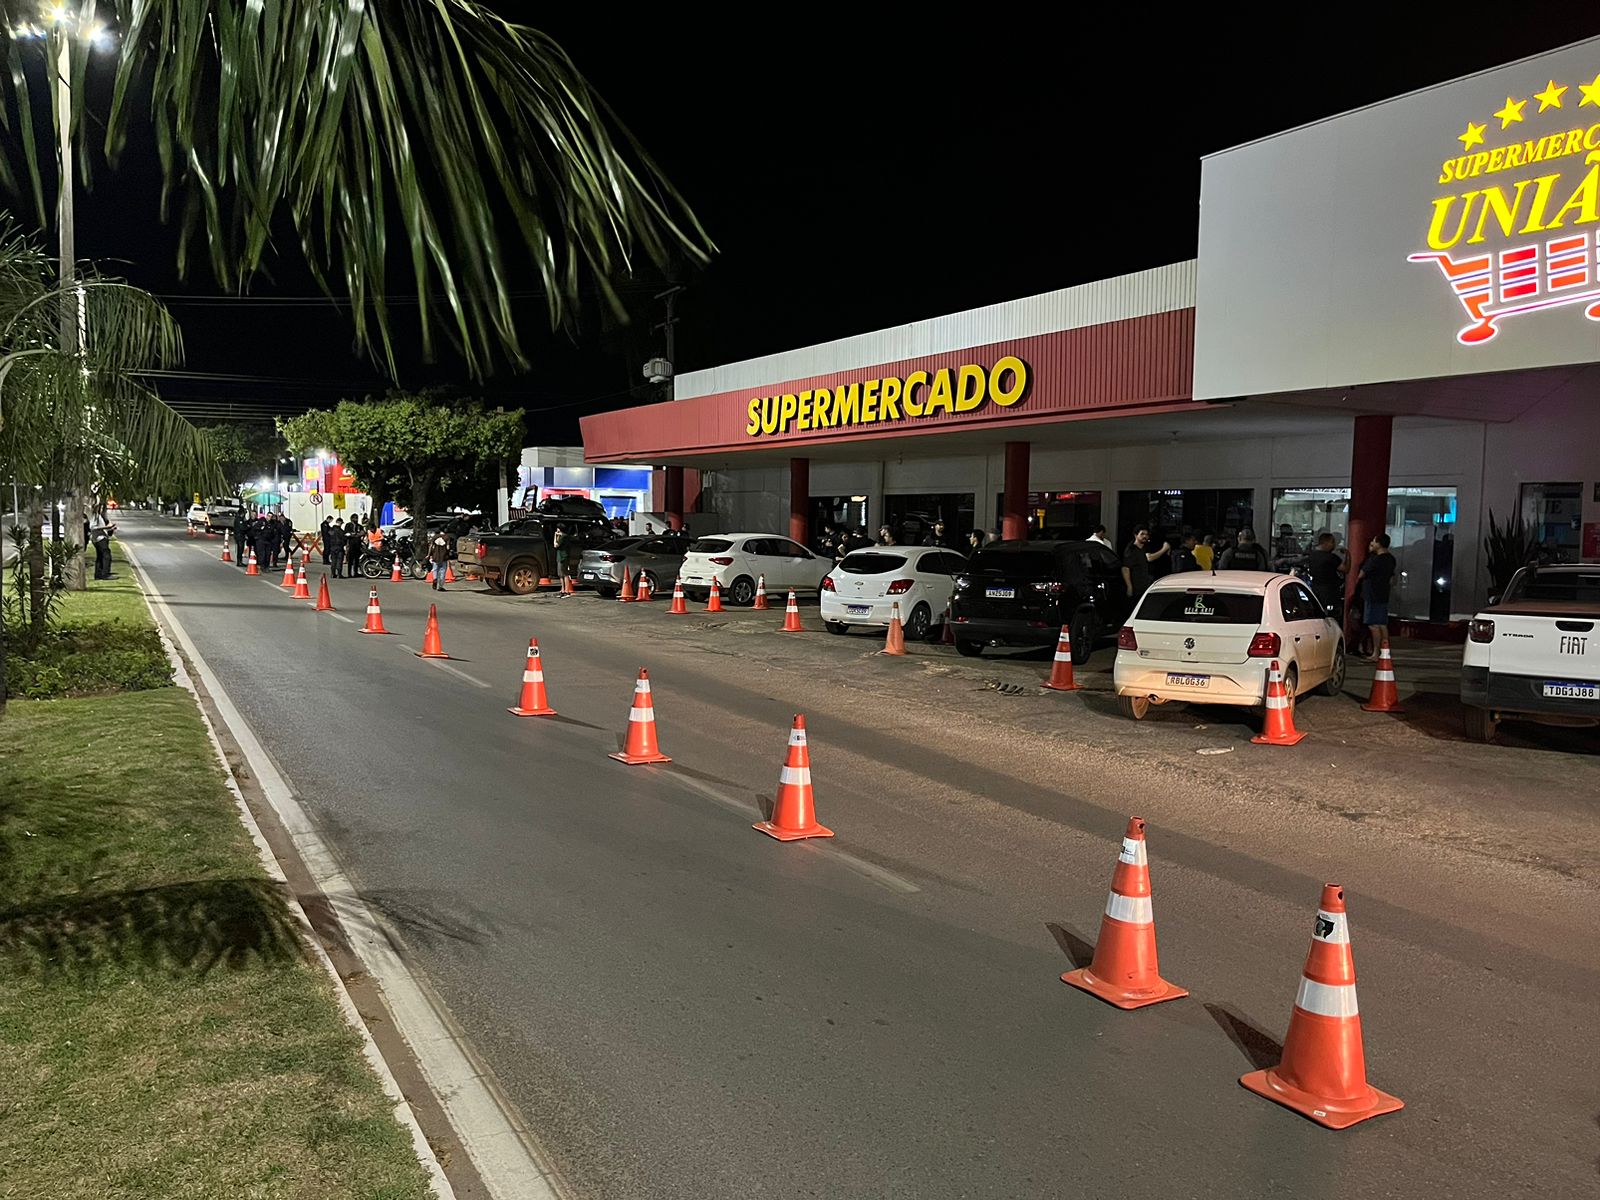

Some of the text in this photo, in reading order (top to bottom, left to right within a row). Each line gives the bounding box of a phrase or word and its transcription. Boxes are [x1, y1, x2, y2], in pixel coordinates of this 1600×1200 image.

[746, 355, 1028, 436] SUPERMERCADO
[1560, 636, 1588, 655] FIAT
[1549, 686, 1594, 697] TDG1J88
